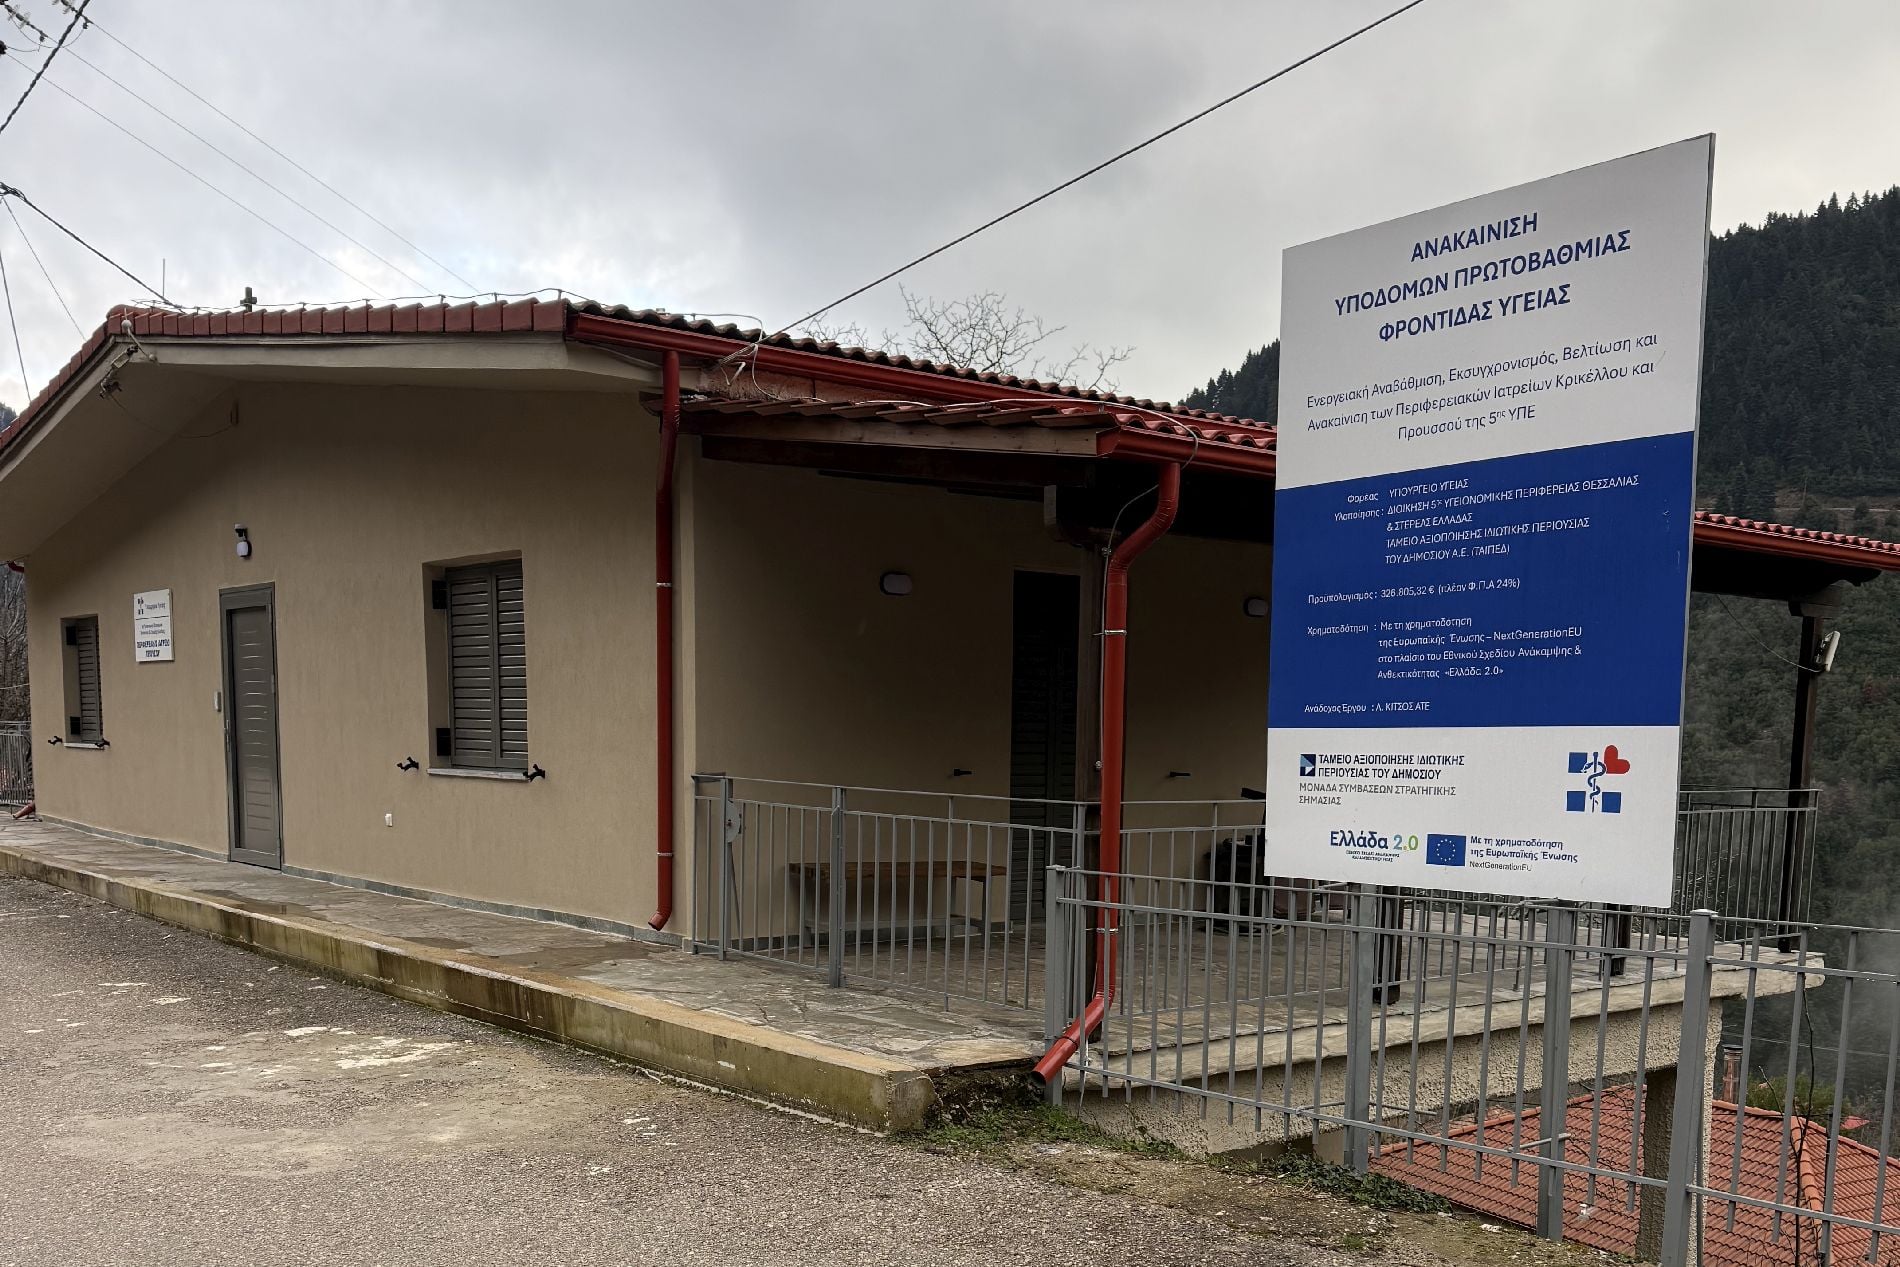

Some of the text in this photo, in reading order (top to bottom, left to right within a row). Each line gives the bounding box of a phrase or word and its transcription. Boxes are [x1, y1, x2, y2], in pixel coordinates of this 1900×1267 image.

[1411, 212, 1538, 262] ΑΝΑΚΑΙΝΙΣΗ
[1335, 230, 1631, 316] ΥΠΟΔΟΜΩΝ ΠΡΩΤΟΒΑΘΜΙΑΣ
[1379, 284, 1571, 342] ΦΡΟΝΤΙΔΑΣ ΥΓΕΙΑΣ
[1307, 334, 1658, 408] Ενεργειακή Αναβάθμιση, Εκσυγχρονισμός, Βελτίωση και
[1307, 362, 1654, 432] Ανακαίνιση των Περιφερειακών Ιατρείων Κρικέλλου και
[1398, 417, 1461, 441] Προυσσού
[1465, 416, 1486, 430] της
[1508, 404, 1536, 421] ΥΠΕ
[1387, 499, 1430, 515] ΔΙΟΙΚΗΣΗ
[1516, 482, 1580, 499] ΠΕΡΙΦΕΡΕΙΑΣ
[1582, 475, 1640, 491] ΘΕΣΣΑΛΙΑΣ
[1389, 478, 1469, 498] ΥΠΟΥΡΓΕΙΟ ΥΓΕΙΑΣ
[1386, 523, 1393, 532] &
[1432, 512, 1473, 526] ΕΛΛΑΔΑΣ
[1386, 517, 1590, 549] ΤΑΜΕΙΟ ΑΞΙΟΠΟΙΗΣΗΣ ΙΔΙΩΤΙΚΗΣ ΠΕΡΙΟΥΣΙΑΣ
[1385, 555, 1402, 564] ΤΟΥ
[1403, 549, 1451, 563] ΔΗΜΟΣΙΟΥ
[1428, 585, 1435, 594] €
[1496, 577, 1521, 589] 24%)
[1380, 621, 1393, 630] Με
[1394, 622, 1404, 630] τη
[1378, 640, 1393, 648] της
[1493, 627, 1582, 641] NextGenerationEU
[1378, 655, 1393, 663] στο
[1427, 653, 1441, 661] του
[1574, 645, 1582, 655] &
[1385, 702, 1414, 711] ΚΙΤΣΟΣ
[1415, 701, 1430, 711] ΑΤΕ
[1318, 754, 1465, 766] ΤΑΜΕΙΟ ΑΞΙΟΠΟΙΗΣΗΣ ΙΔΙΩΤΙΚΗΣ
[1318, 767, 1441, 780] ΠΕΡΙΟΥΣΙΑΣ ΤΟΥ ΔΗΜΟΣΙΟΥ
[1299, 783, 1456, 796] ΜΟΝΑΔΑ ΣΥΜΒΑΣΕΩΝ ΣΤΡΑΤΗΓΙΚΗΣ
[1299, 796, 1342, 805] ΣΗΜΑΣΙΑΣ
[1330, 830, 1419, 851] Ελλάδα 2.0
[1470, 836, 1563, 851] Με τη χρηματοδότηση
[1471, 849, 1484, 858] της
[1540, 851, 1578, 863] Ένωσης
